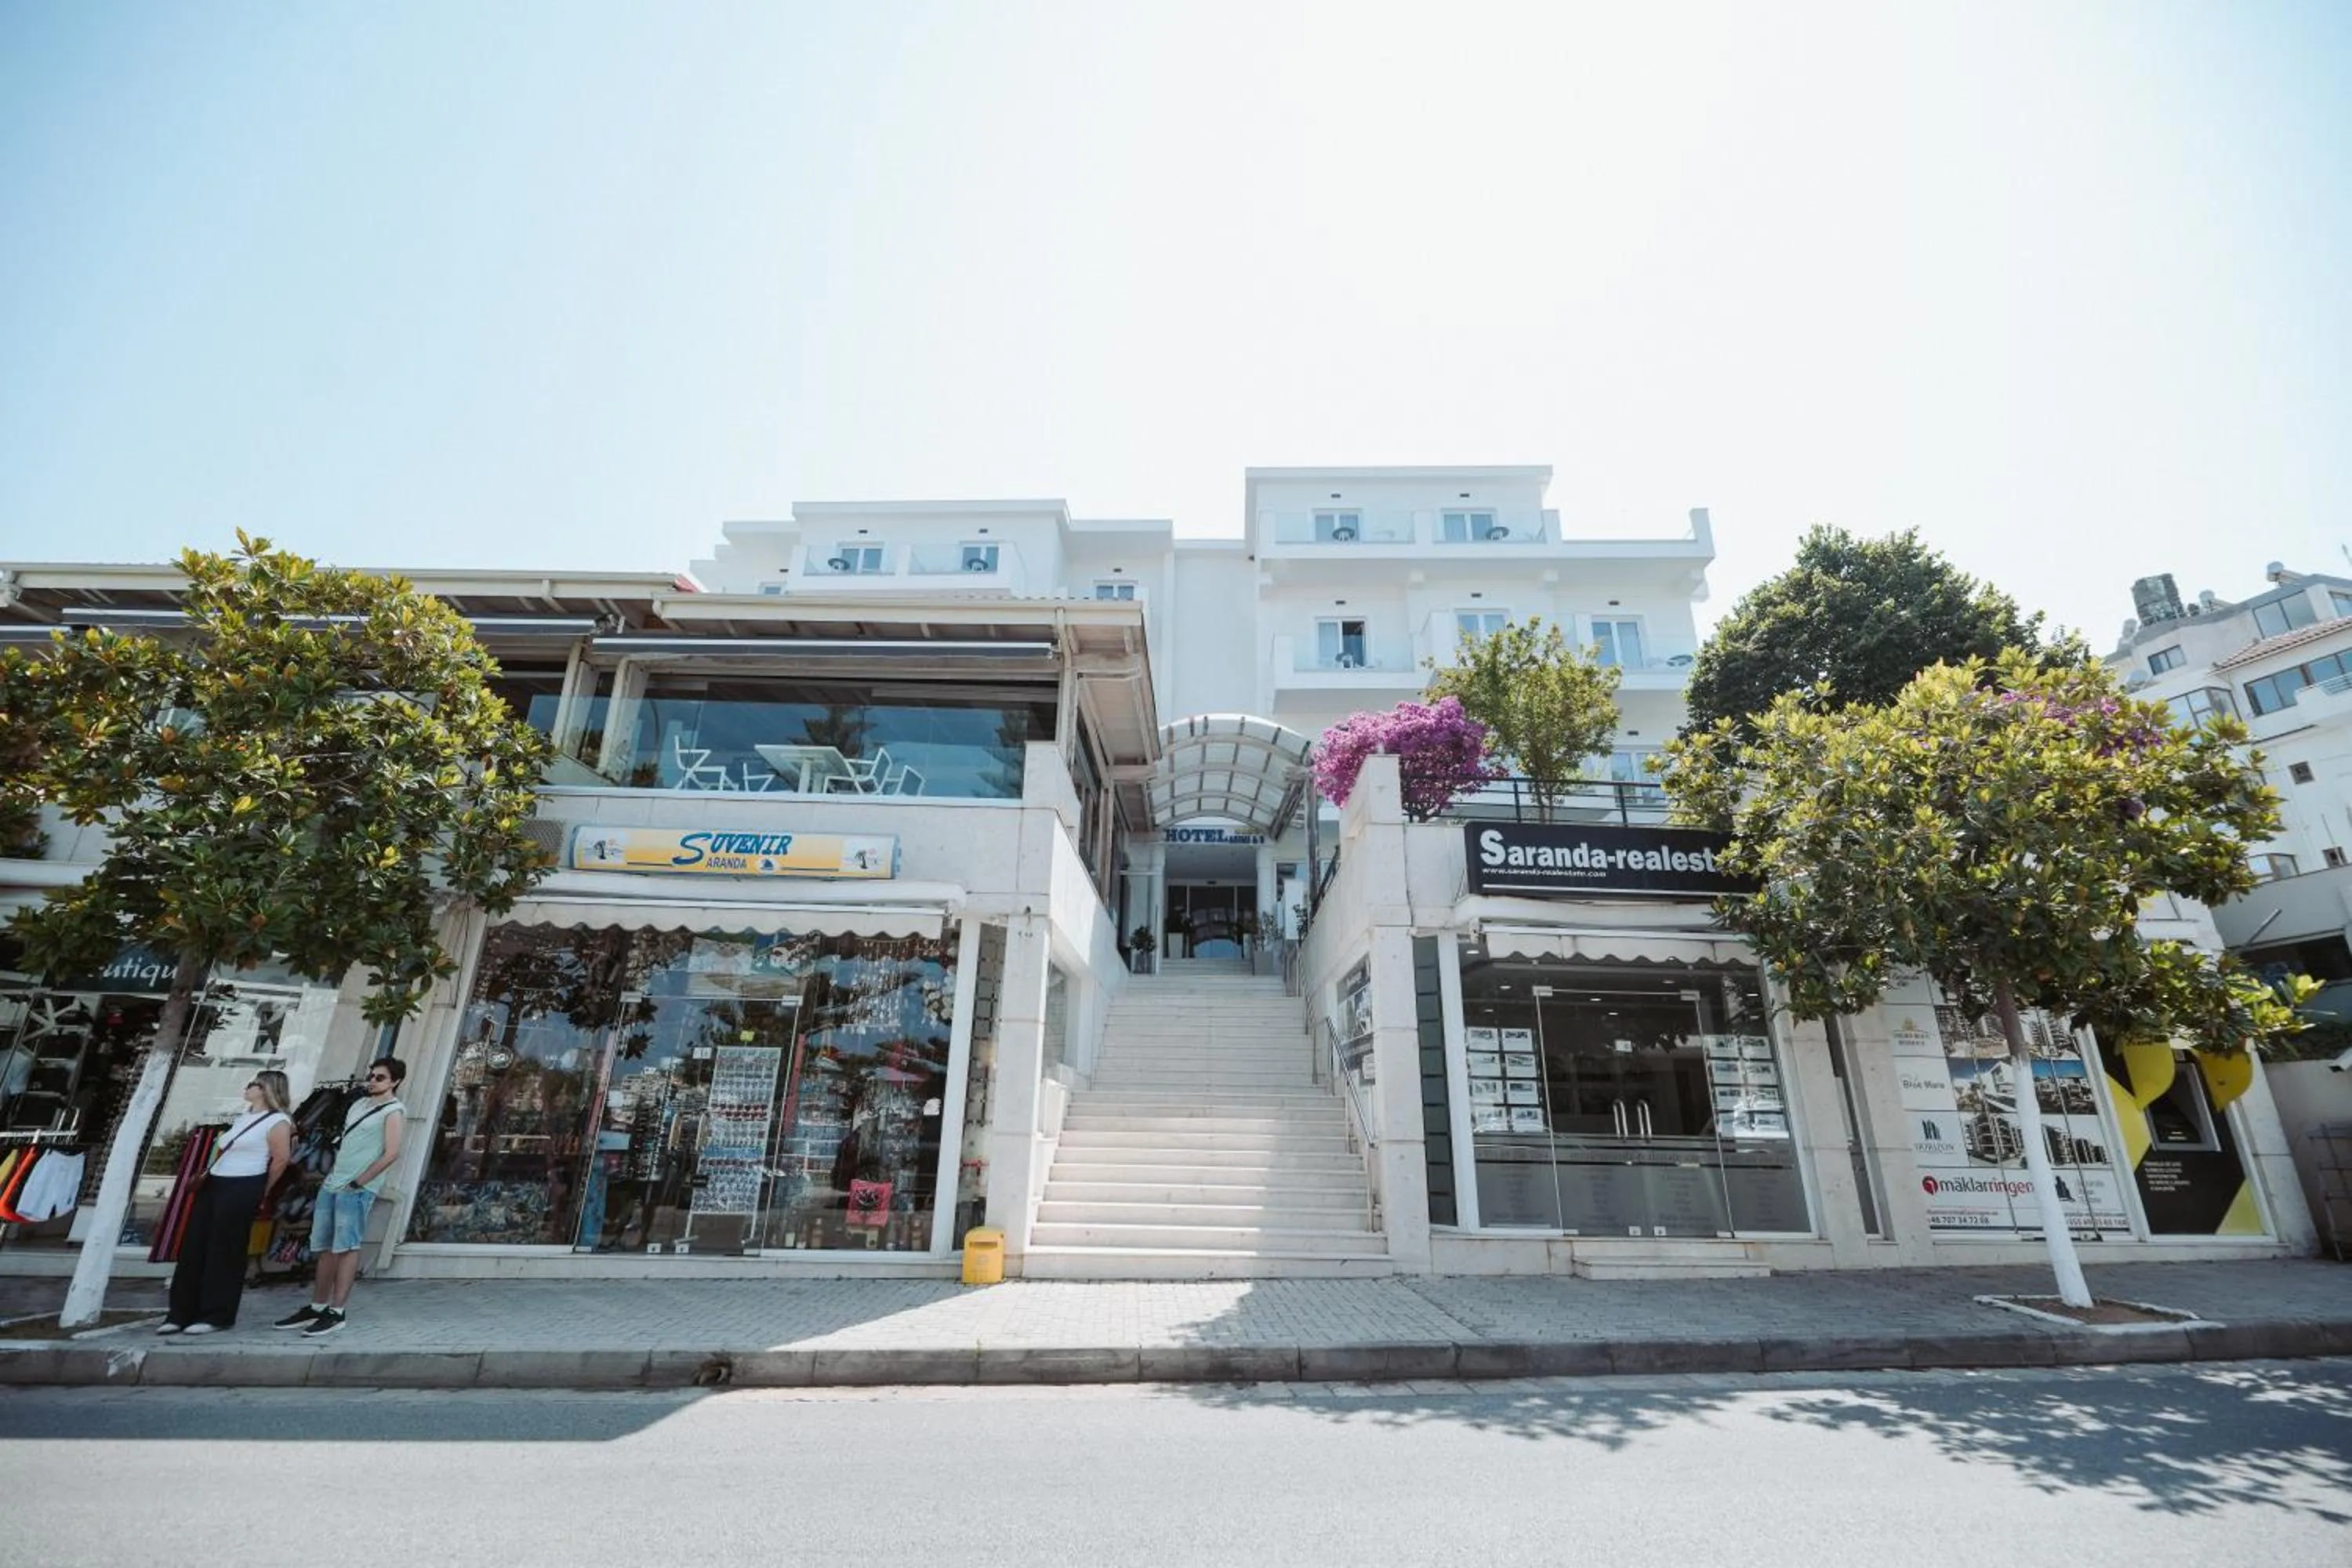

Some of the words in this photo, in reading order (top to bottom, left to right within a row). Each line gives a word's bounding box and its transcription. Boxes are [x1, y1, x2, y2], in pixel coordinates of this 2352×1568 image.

[672, 832, 793, 866] SUVENIR
[1164, 828, 1227, 843] HOTEL
[1479, 829, 1716, 873] Saranda-realest
[89, 956, 179, 987] utiqu
[1939, 1177, 2034, 1197] mäklarringen
